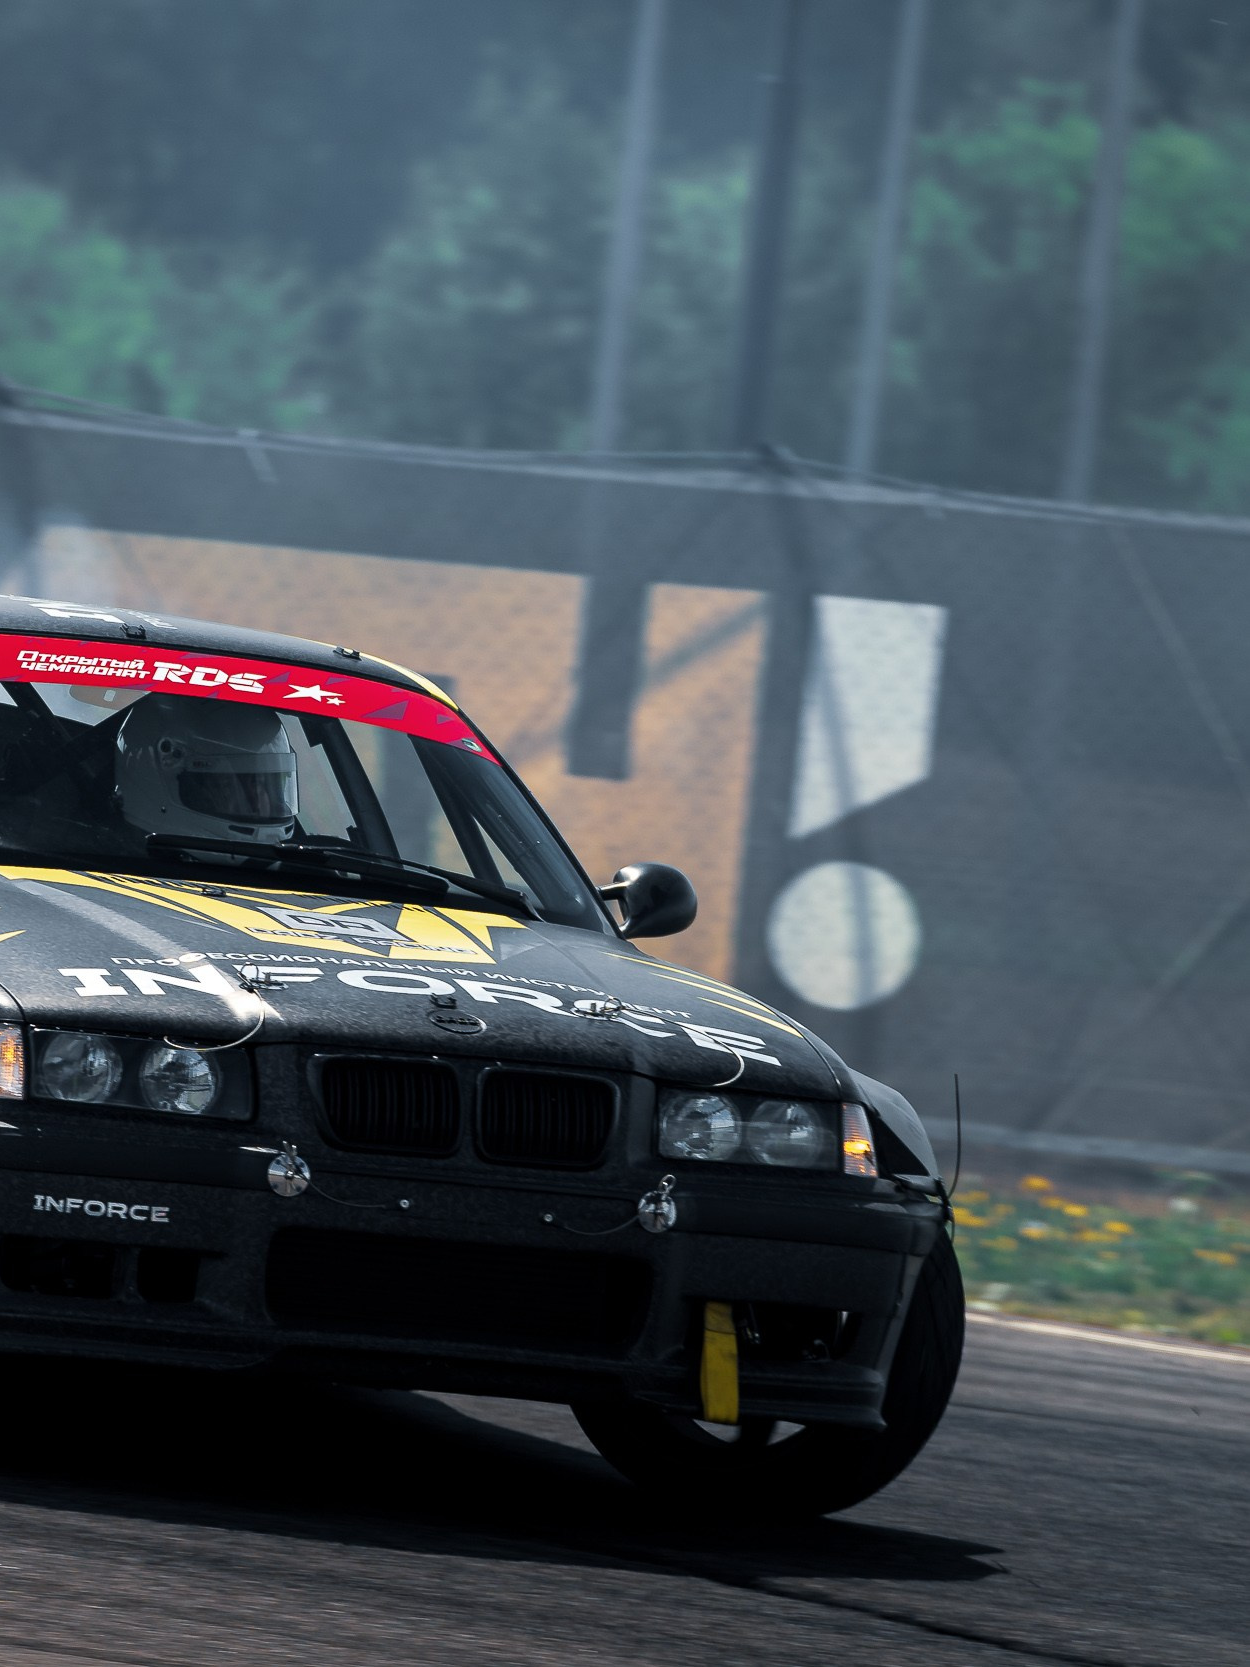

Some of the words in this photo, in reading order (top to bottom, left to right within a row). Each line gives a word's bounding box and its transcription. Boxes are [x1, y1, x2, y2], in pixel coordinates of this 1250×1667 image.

[16, 650, 145, 670] ОТКРЫТЫЙ
[20, 661, 150, 679] ЧЕМПИОНАТ
[151, 660, 267, 693] RDS
[111, 952, 478, 978] ПРОФЕССИОНАЛЬНЫЙ
[57, 962, 782, 1068] INFORCE
[33, 1194, 170, 1223] INFORCE
